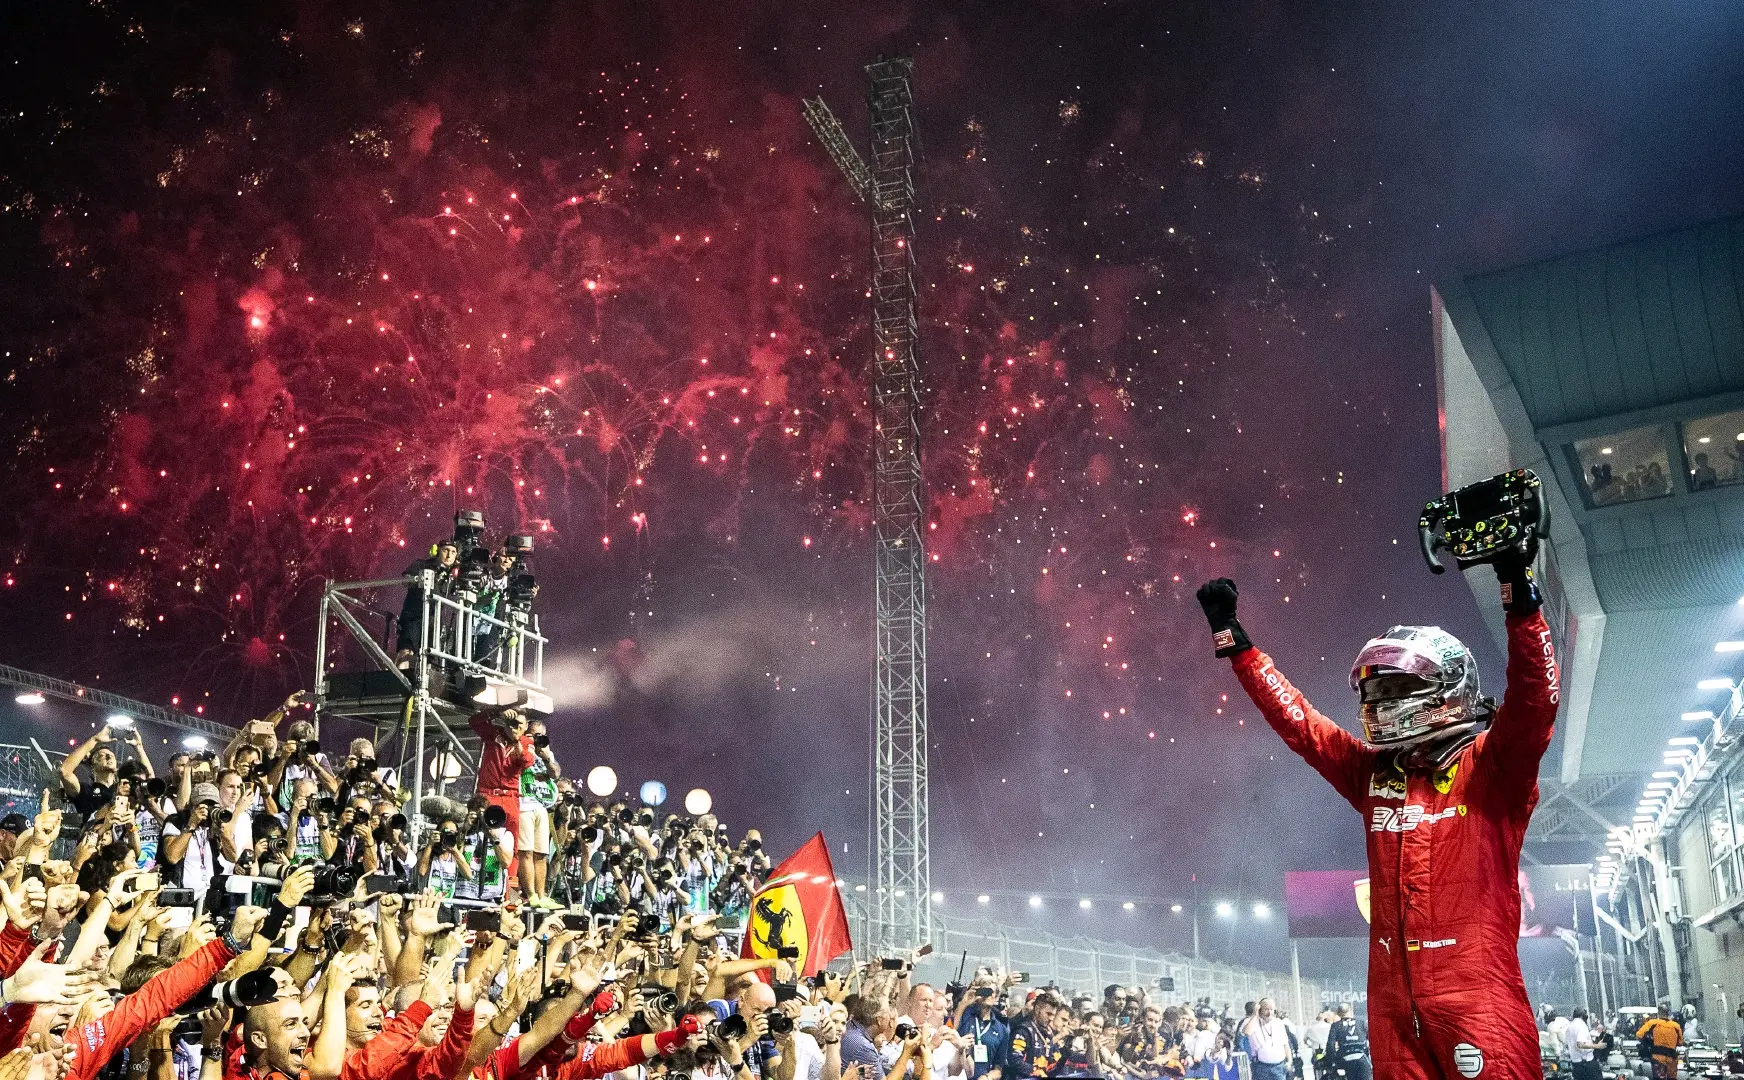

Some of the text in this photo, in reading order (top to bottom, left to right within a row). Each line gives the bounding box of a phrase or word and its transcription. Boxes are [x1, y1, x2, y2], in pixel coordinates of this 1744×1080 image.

[1540, 630, 1559, 704] Lenovo
[1260, 663, 1304, 721] Lenovo
[1320, 990, 1367, 1003] SINGAP
[1455, 1048, 1482, 1073] 5
